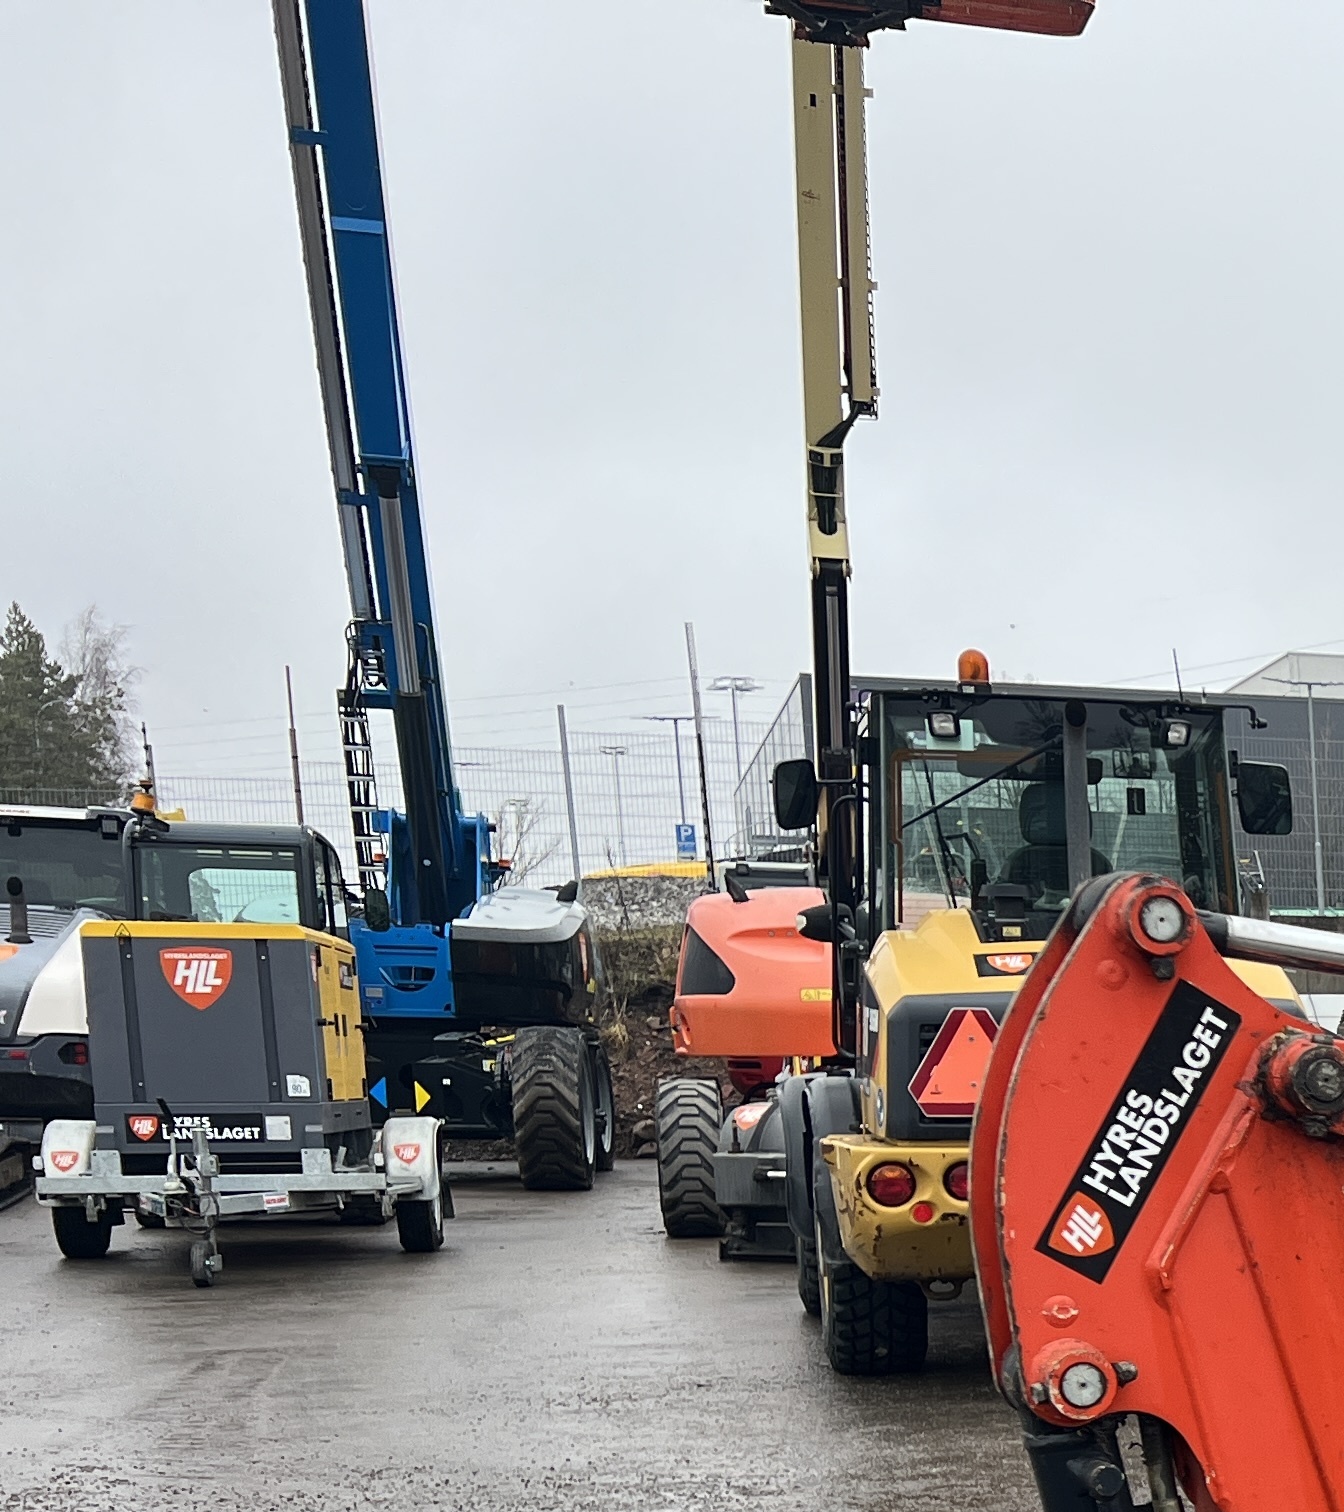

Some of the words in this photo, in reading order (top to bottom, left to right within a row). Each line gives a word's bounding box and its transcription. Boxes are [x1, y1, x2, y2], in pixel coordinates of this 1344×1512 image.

[680, 826, 692, 841] P
[173, 959, 223, 994] HLL
[1106, 1005, 1229, 1208] LANDSLAGET
[162, 1127, 260, 1140] LANSLAGET
[1081, 1088, 1154, 1194] HYRES
[1060, 1204, 1105, 1253] HLL
